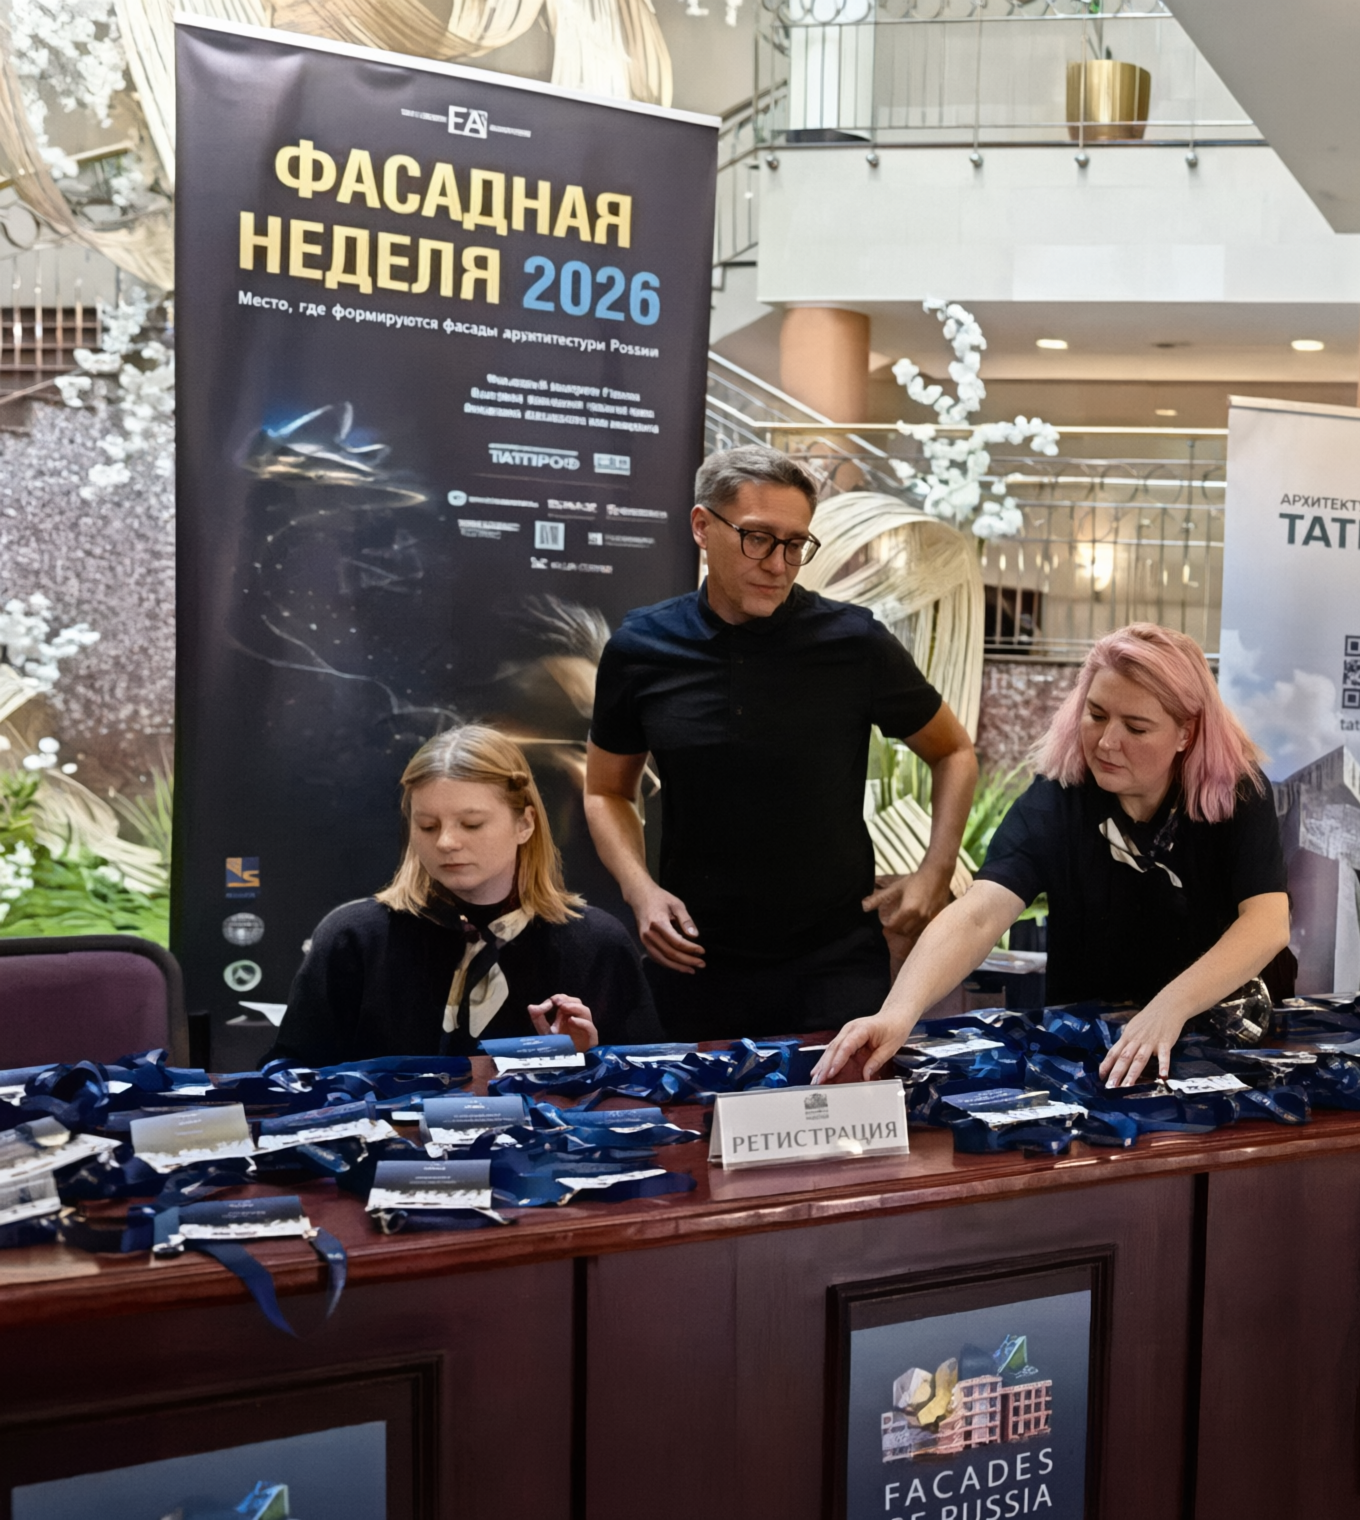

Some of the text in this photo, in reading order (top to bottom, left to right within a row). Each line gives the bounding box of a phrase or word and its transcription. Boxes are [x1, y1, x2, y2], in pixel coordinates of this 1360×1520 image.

[274, 139, 632, 249] ФАСАДНАЯ
[239, 211, 661, 326] НЕДЕЛЯ 2026
[238, 290, 293, 314] Место,
[299, 302, 326, 317] где
[332, 303, 439, 330] формируются
[443, 318, 498, 338] фасады
[885, 1447, 1054, 1511] FACADES
